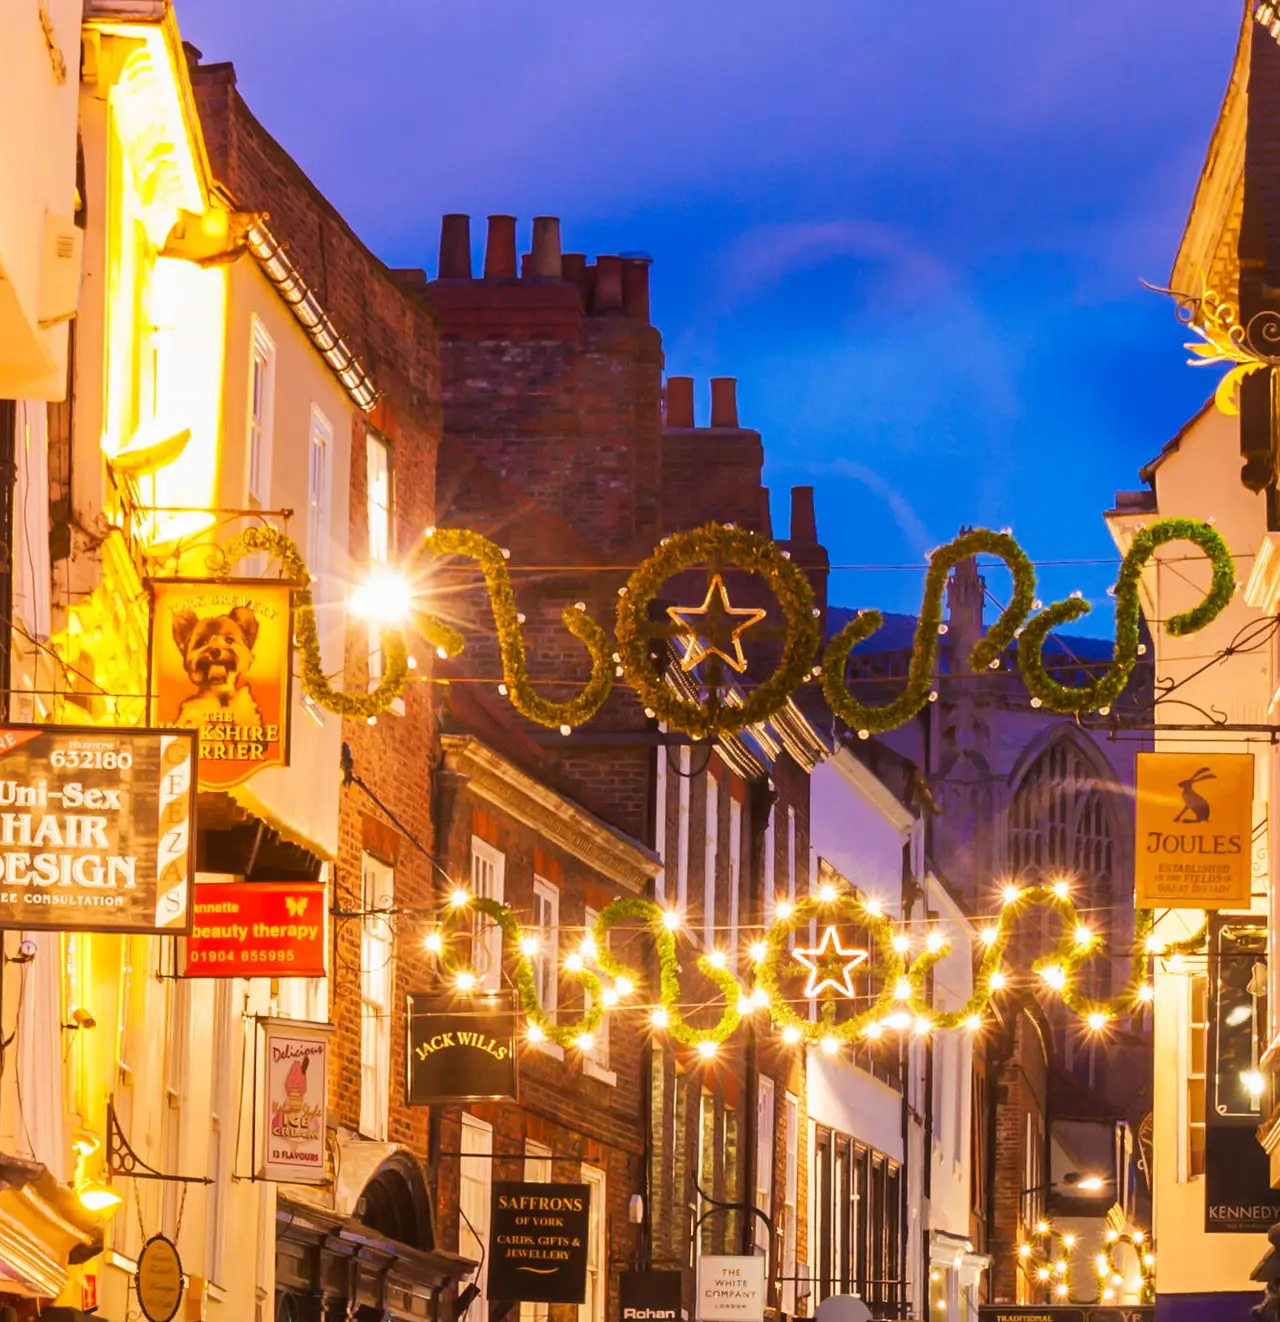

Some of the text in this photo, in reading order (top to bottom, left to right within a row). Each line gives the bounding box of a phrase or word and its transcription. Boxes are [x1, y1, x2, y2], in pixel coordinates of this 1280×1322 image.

[205, 712, 236, 723] THE
[200, 744, 265, 760] RRIER
[51, 750, 133, 770] 632180
[0, 813, 111, 848] HAIR
[1147, 832, 1242, 854] JOULES
[1158, 864, 1231, 873] ESTABLISHED
[24, 893, 124, 906] CONSULTATION
[192, 924, 319, 942] beauty therapy
[190, 950, 234, 962] 01904
[415, 1031, 508, 1061] JACK WILLS
[272, 1044, 323, 1063] Delicious
[281, 1113, 309, 1129] ICE
[272, 1150, 319, 1161] 12 FLAVOURS
[499, 1195, 583, 1212] SAFFRONS
[515, 1216, 564, 1227] OF YORK
[537, 1236, 569, 1246] GIFTS
[571, 1237, 581, 1247] &
[505, 1249, 570, 1260] JEWELLERY
[722, 1268, 740, 1277] THE
[715, 1279, 748, 1288] WHITE
[705, 1290, 757, 1298] COMPANY
[623, 1308, 676, 1319] Rohan
[996, 1315, 1053, 1322] TRADITIONAL
